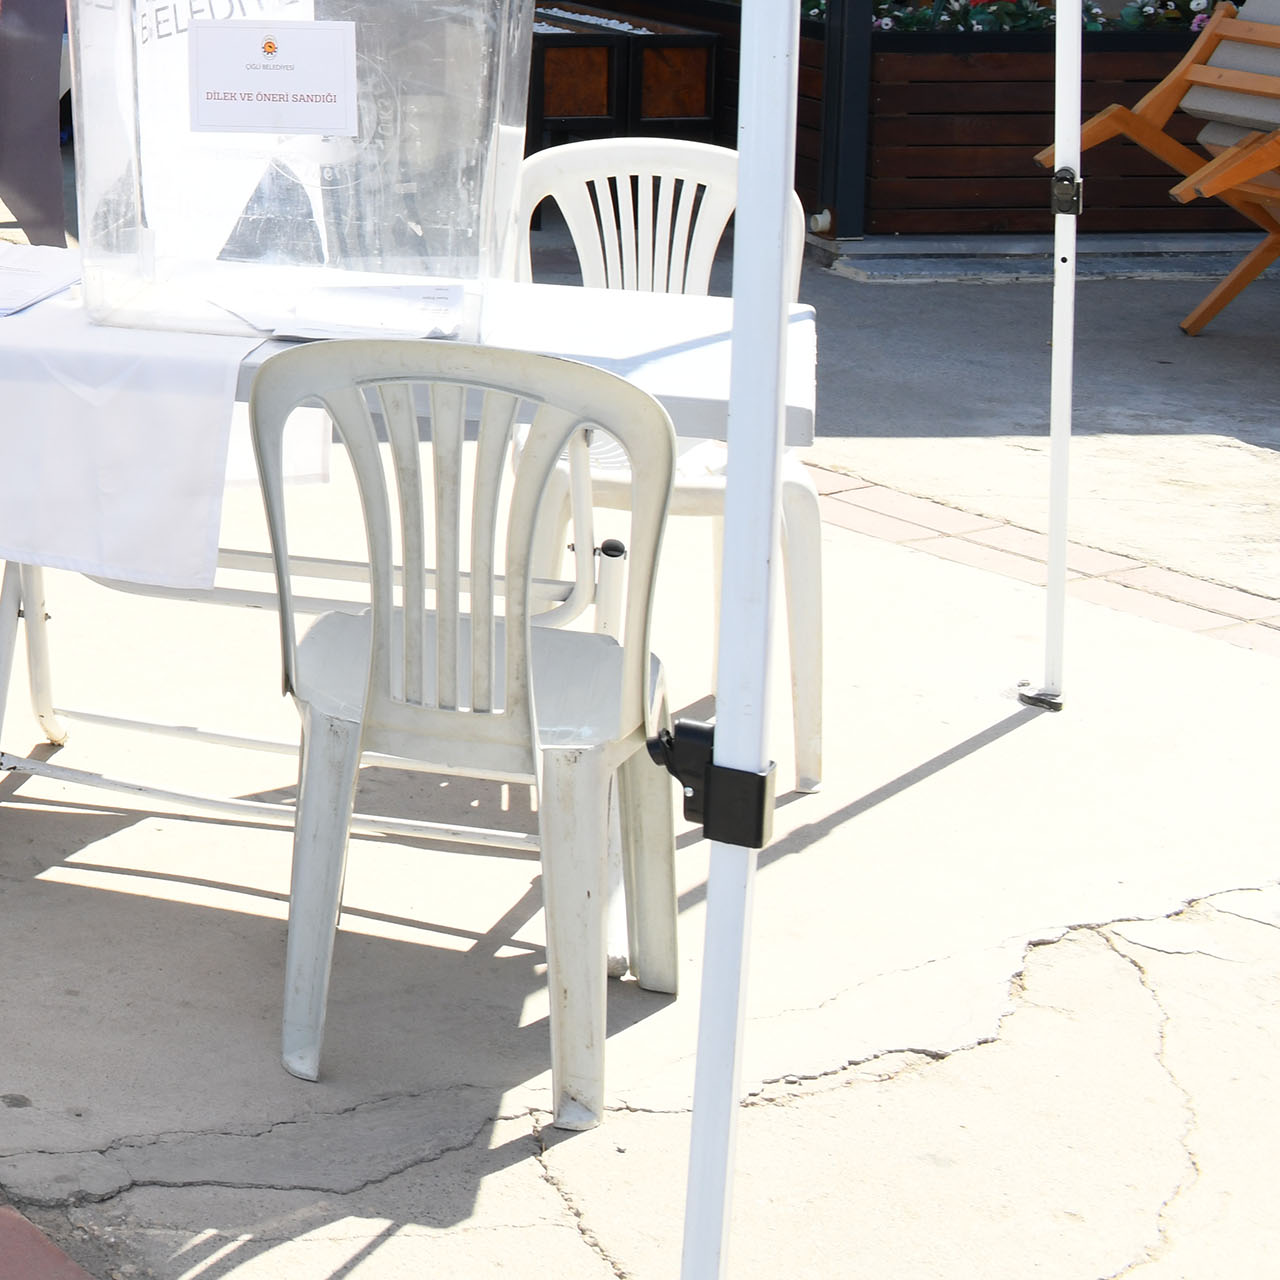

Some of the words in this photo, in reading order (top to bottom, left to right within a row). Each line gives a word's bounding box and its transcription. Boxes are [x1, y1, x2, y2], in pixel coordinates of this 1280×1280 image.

[262, 63, 295, 71] BELEDİYESİ
[205, 90, 238, 101] DİLEK
[240, 92, 254, 102] VE
[257, 90, 289, 103] ÖNERİ
[291, 91, 337, 104] SANDIĞI
